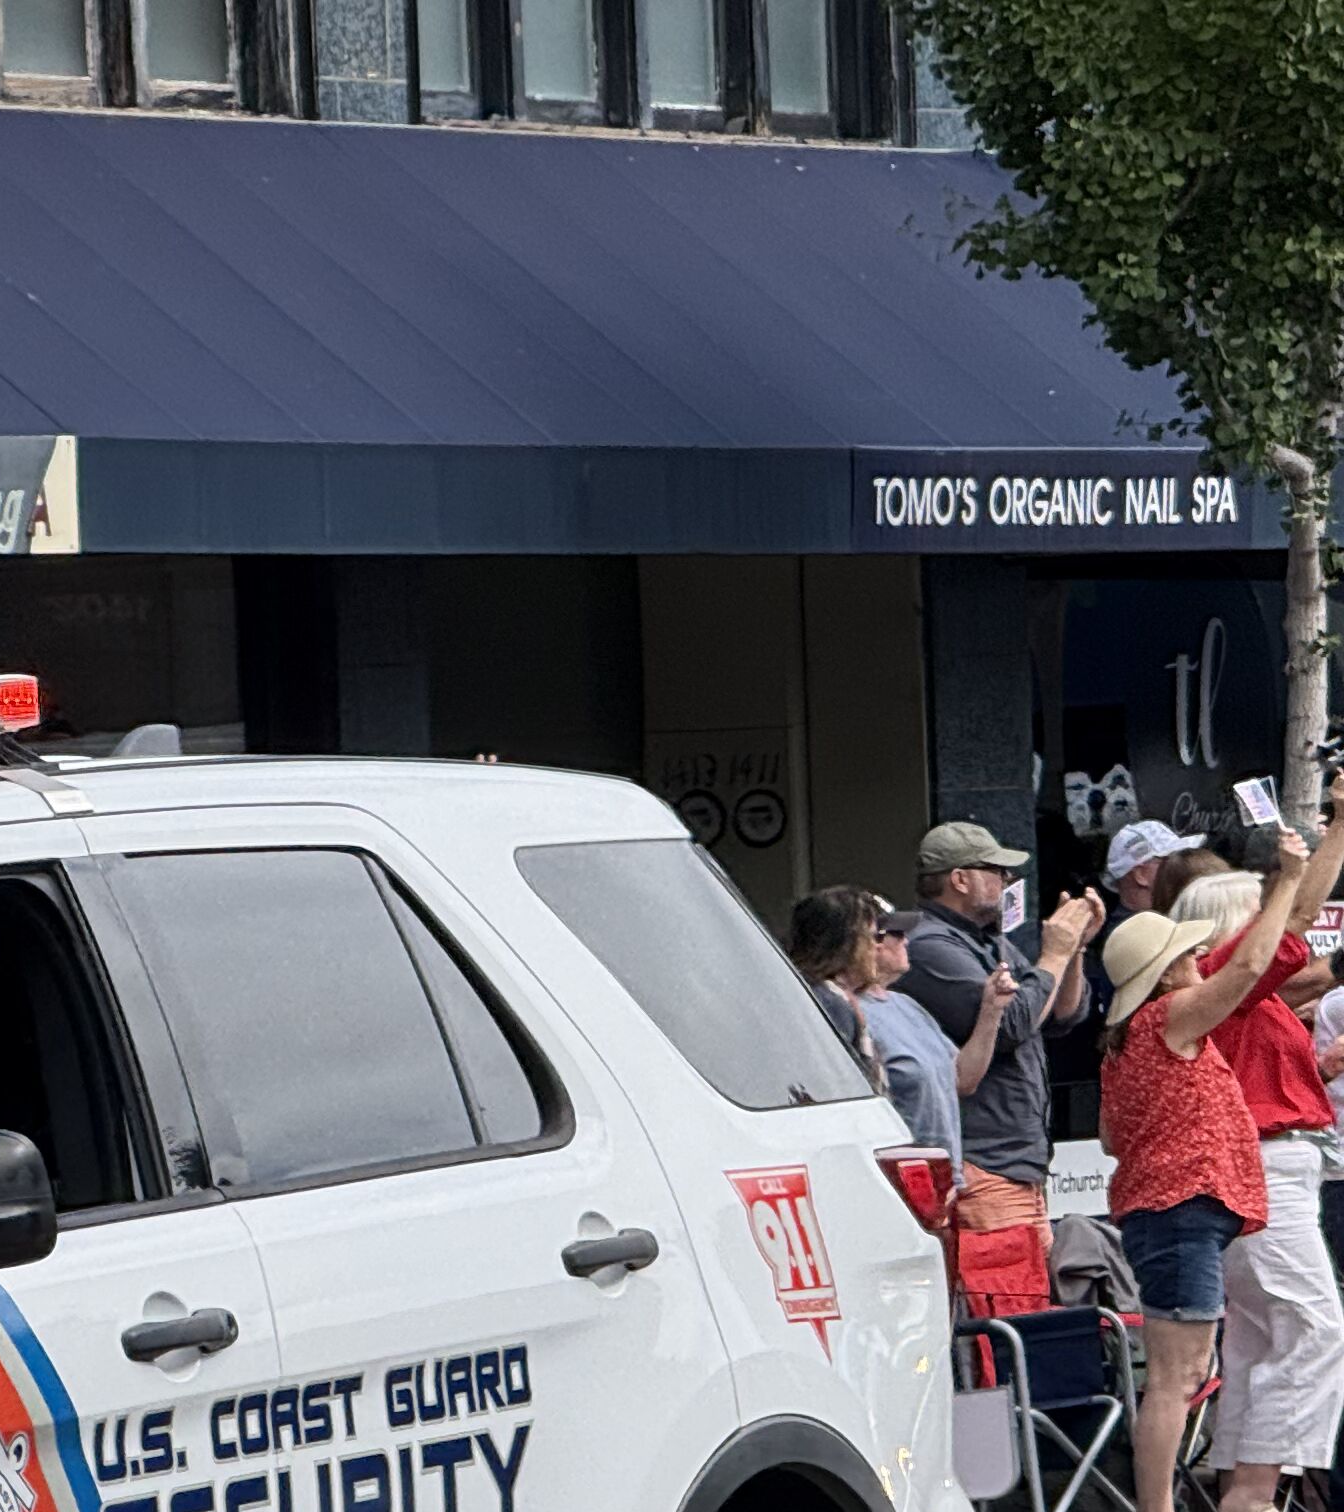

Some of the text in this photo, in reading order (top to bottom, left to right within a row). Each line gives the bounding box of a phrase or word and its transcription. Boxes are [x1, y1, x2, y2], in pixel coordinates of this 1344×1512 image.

[872, 475, 1239, 527] TOMO'S ORGANIC NAIL SPA
[93, 1342, 533, 1486] U.S. COAST GUARD
